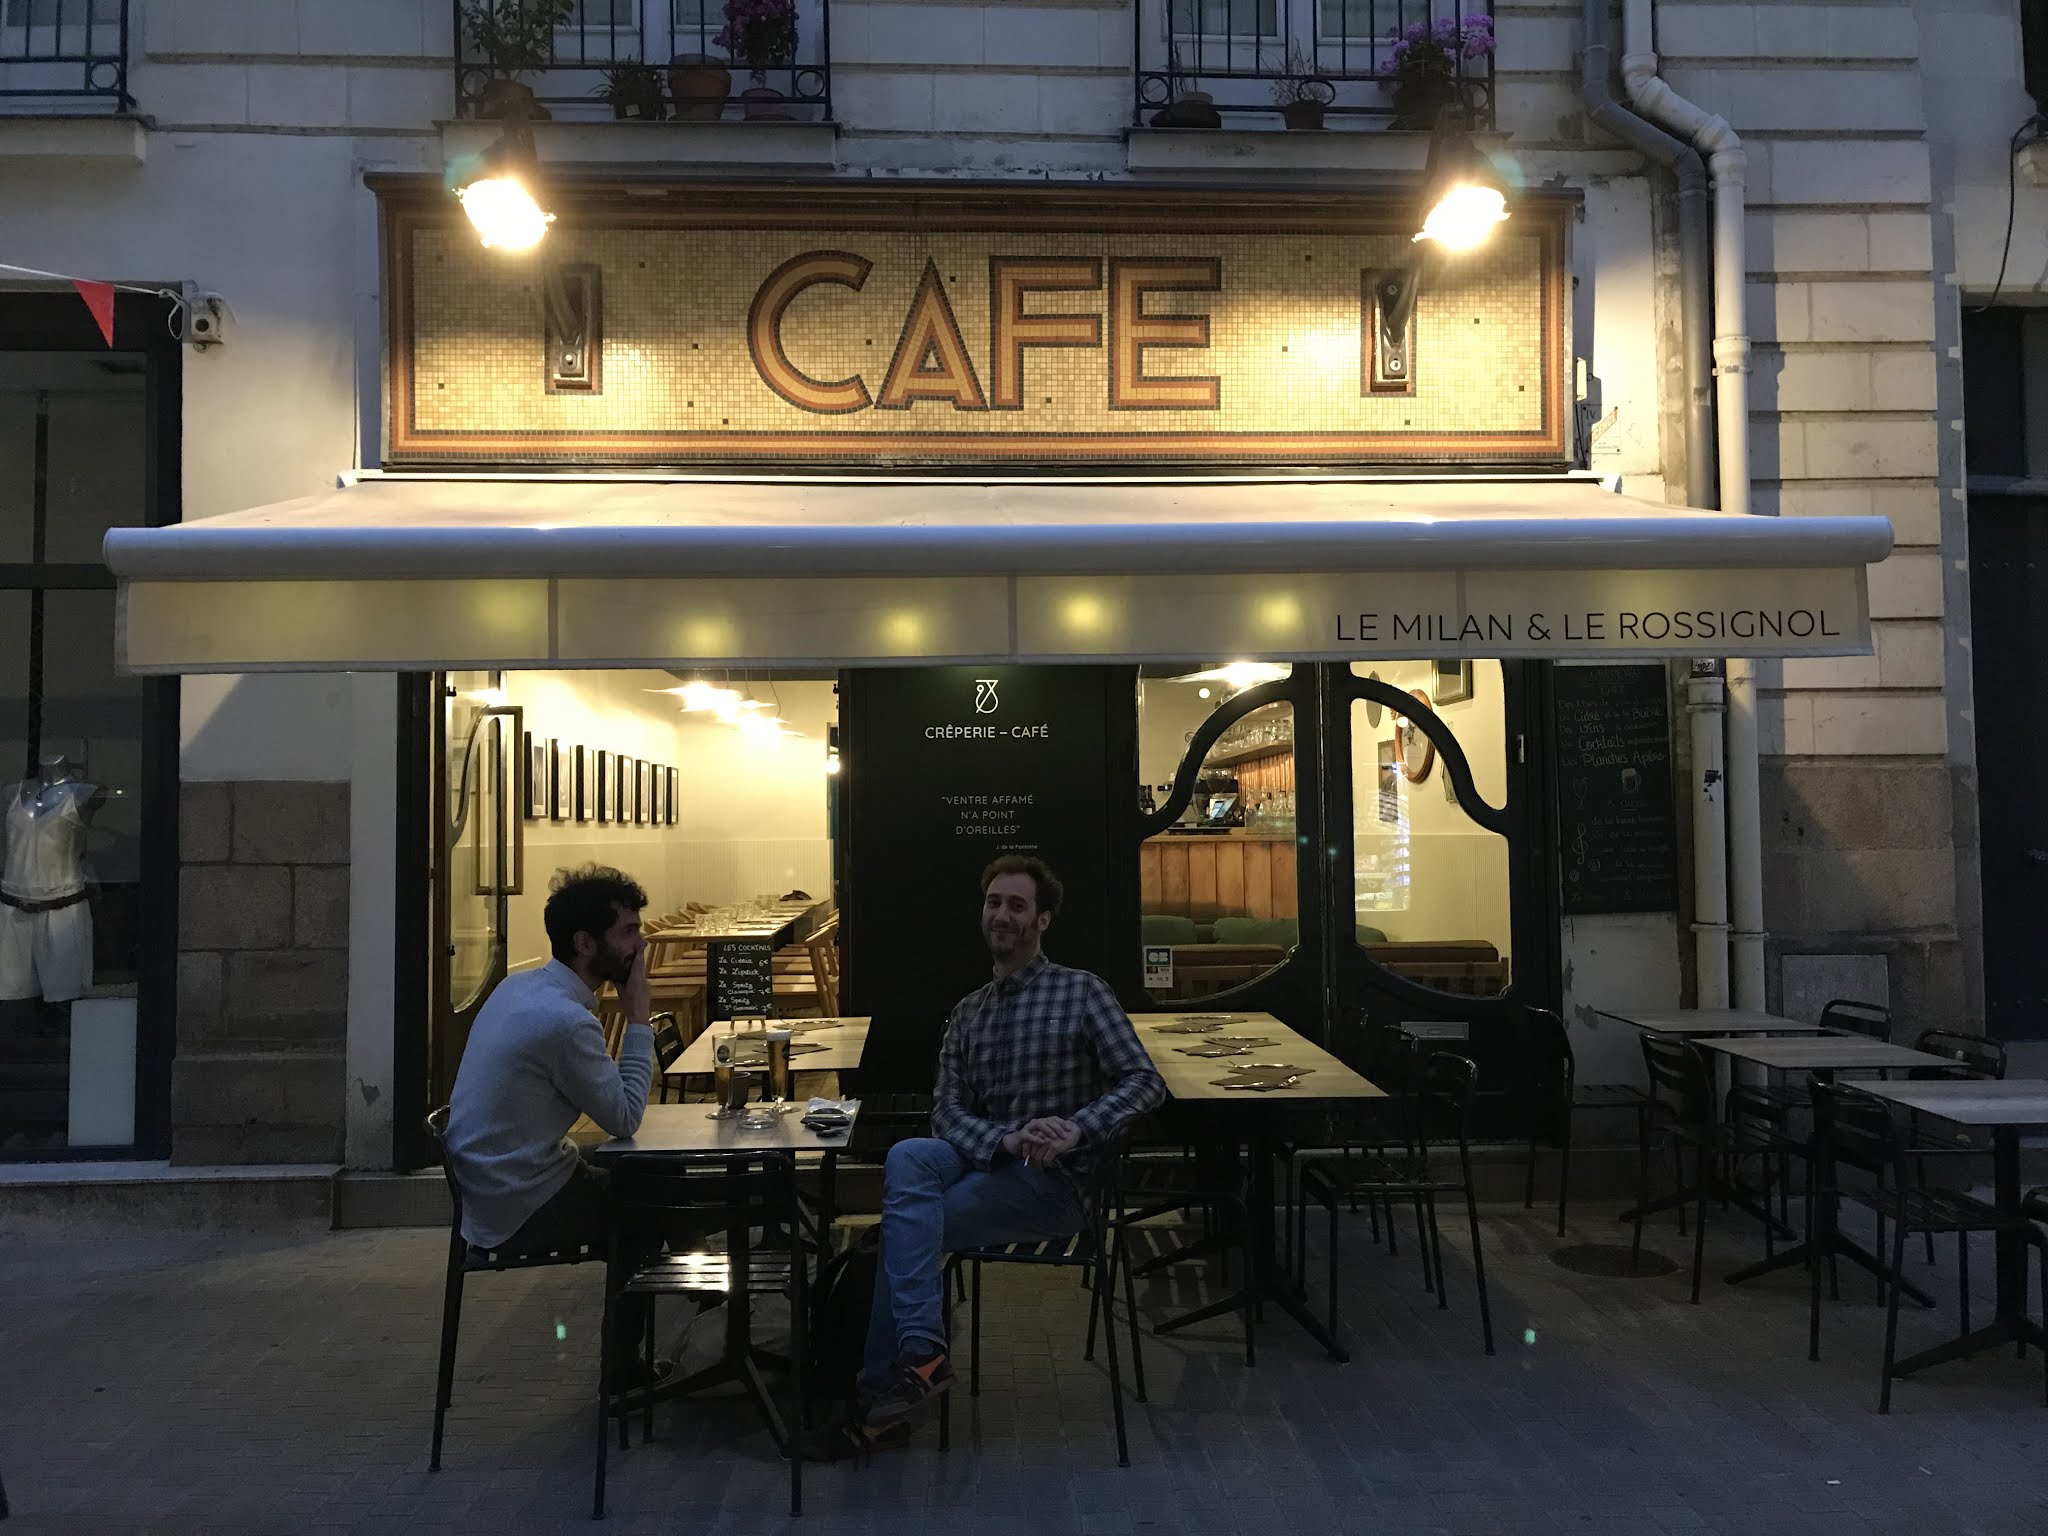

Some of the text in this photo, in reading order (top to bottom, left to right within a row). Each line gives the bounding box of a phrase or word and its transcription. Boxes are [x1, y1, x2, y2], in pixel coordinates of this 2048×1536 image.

[747, 249, 1222, 415] CAFE
[1337, 609, 1841, 641] LE MILAN & LE ROSSIGNOL
[924, 724, 996, 739] CRÊPERIE
[1011, 723, 1049, 738] CAFÉ
[1578, 733, 1625, 751] Cocktails
[991, 794, 1035, 805] AFFAMÉ
[961, 810, 1015, 820] N'A POINT
[723, 944, 771, 952] LES COCKTAILS
